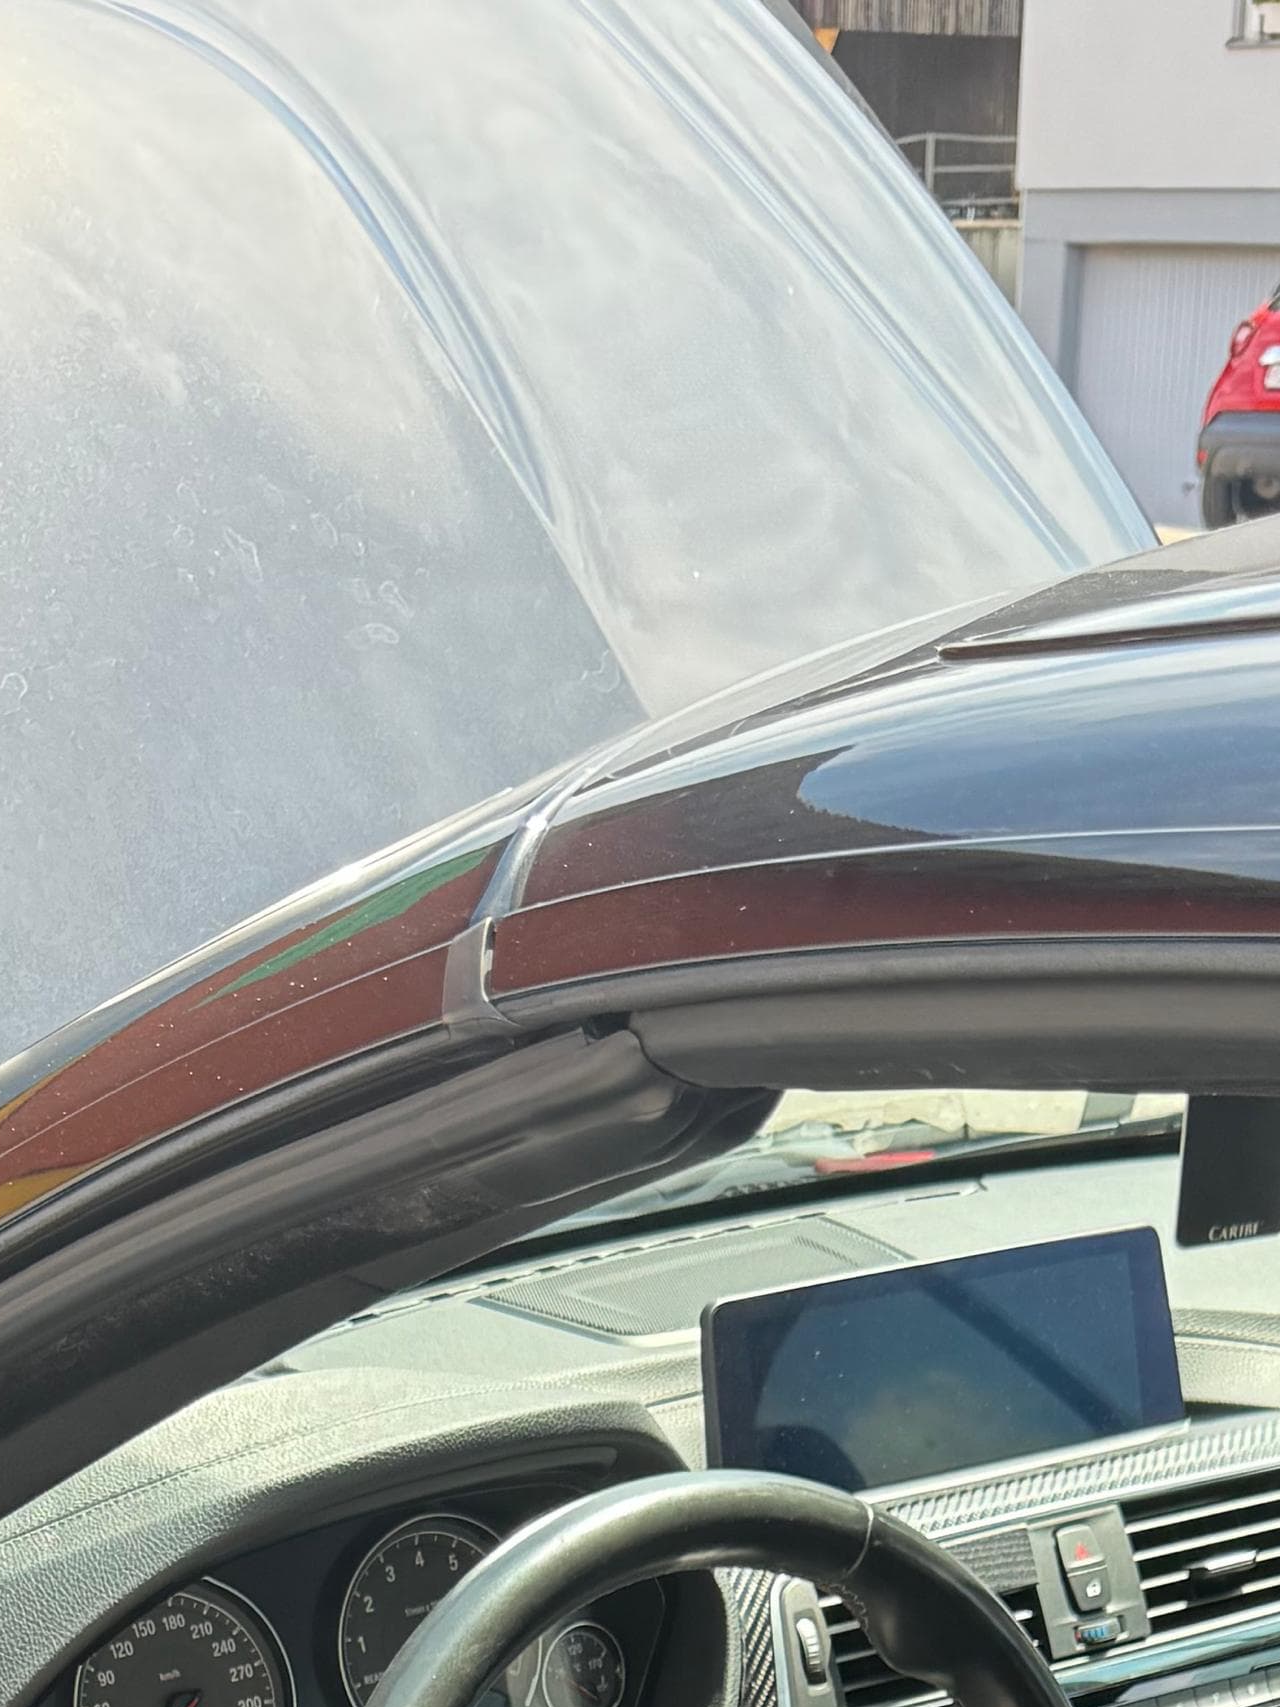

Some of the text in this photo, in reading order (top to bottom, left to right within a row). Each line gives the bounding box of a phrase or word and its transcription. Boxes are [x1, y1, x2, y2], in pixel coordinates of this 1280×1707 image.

[415, 1551, 425, 1566] 4
[449, 1555, 458, 1571] 5
[385, 1566, 396, 1583] 3
[363, 1596, 374, 1613] 2
[132, 1621, 156, 1639] 150
[162, 1613, 186, 1631] 180
[190, 1621, 213, 1640] 210
[110, 1640, 134, 1660] 120
[212, 1638, 236, 1657] 240
[357, 1636, 367, 1653] 1
[97, 1670, 115, 1687] 90
[229, 1663, 254, 1683] 270
